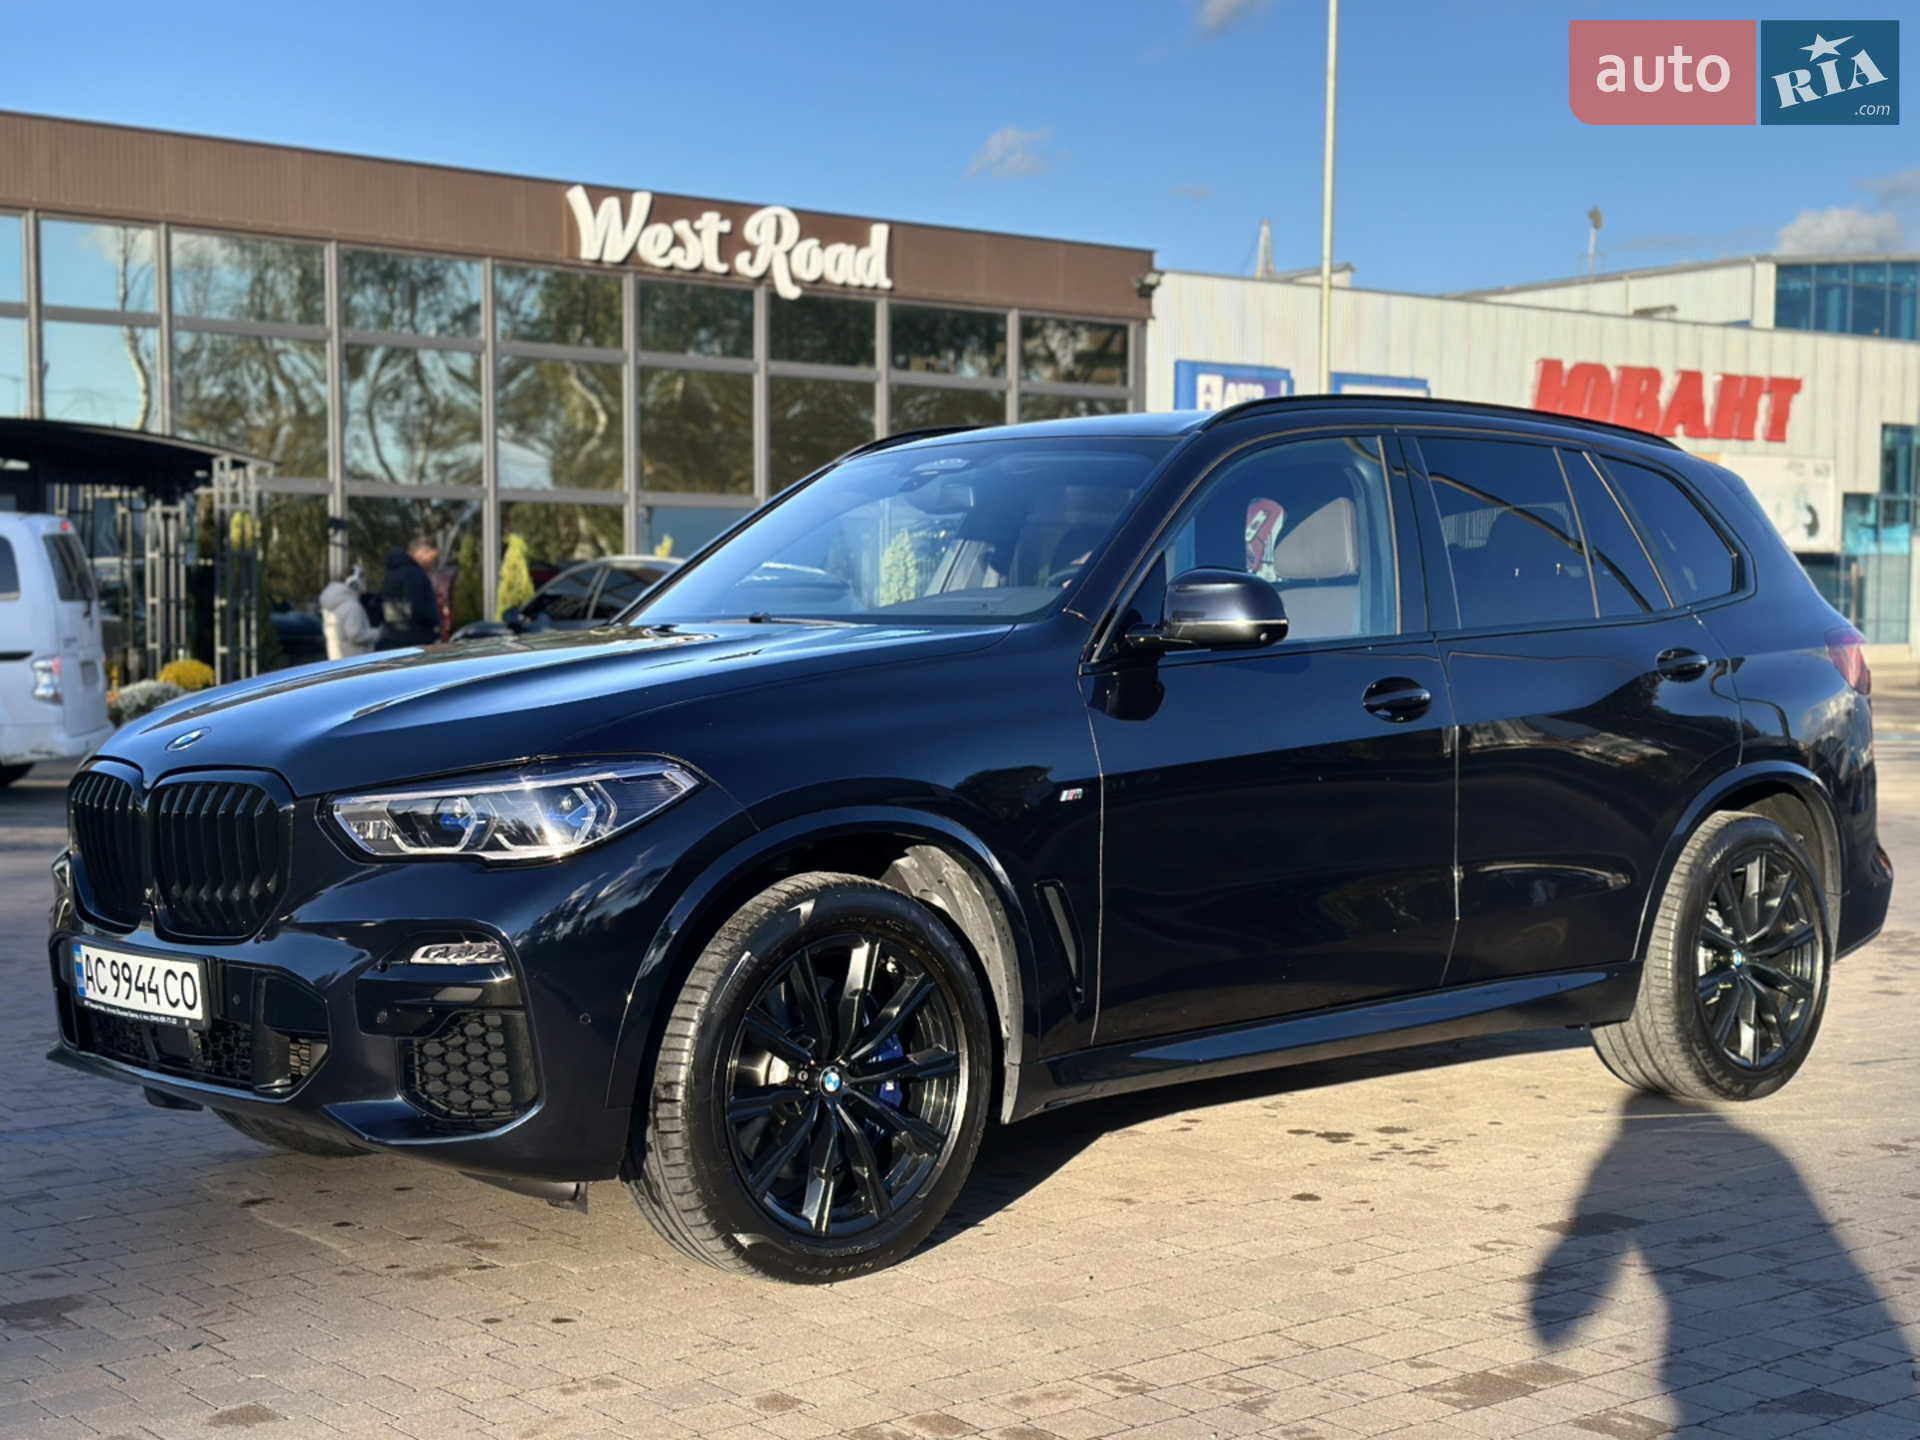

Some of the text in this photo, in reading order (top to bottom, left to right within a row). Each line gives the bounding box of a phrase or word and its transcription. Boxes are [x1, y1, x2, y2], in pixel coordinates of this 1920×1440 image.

[566, 184, 893, 300] West Road
[1533, 358, 1803, 442] ЮВАНТ
